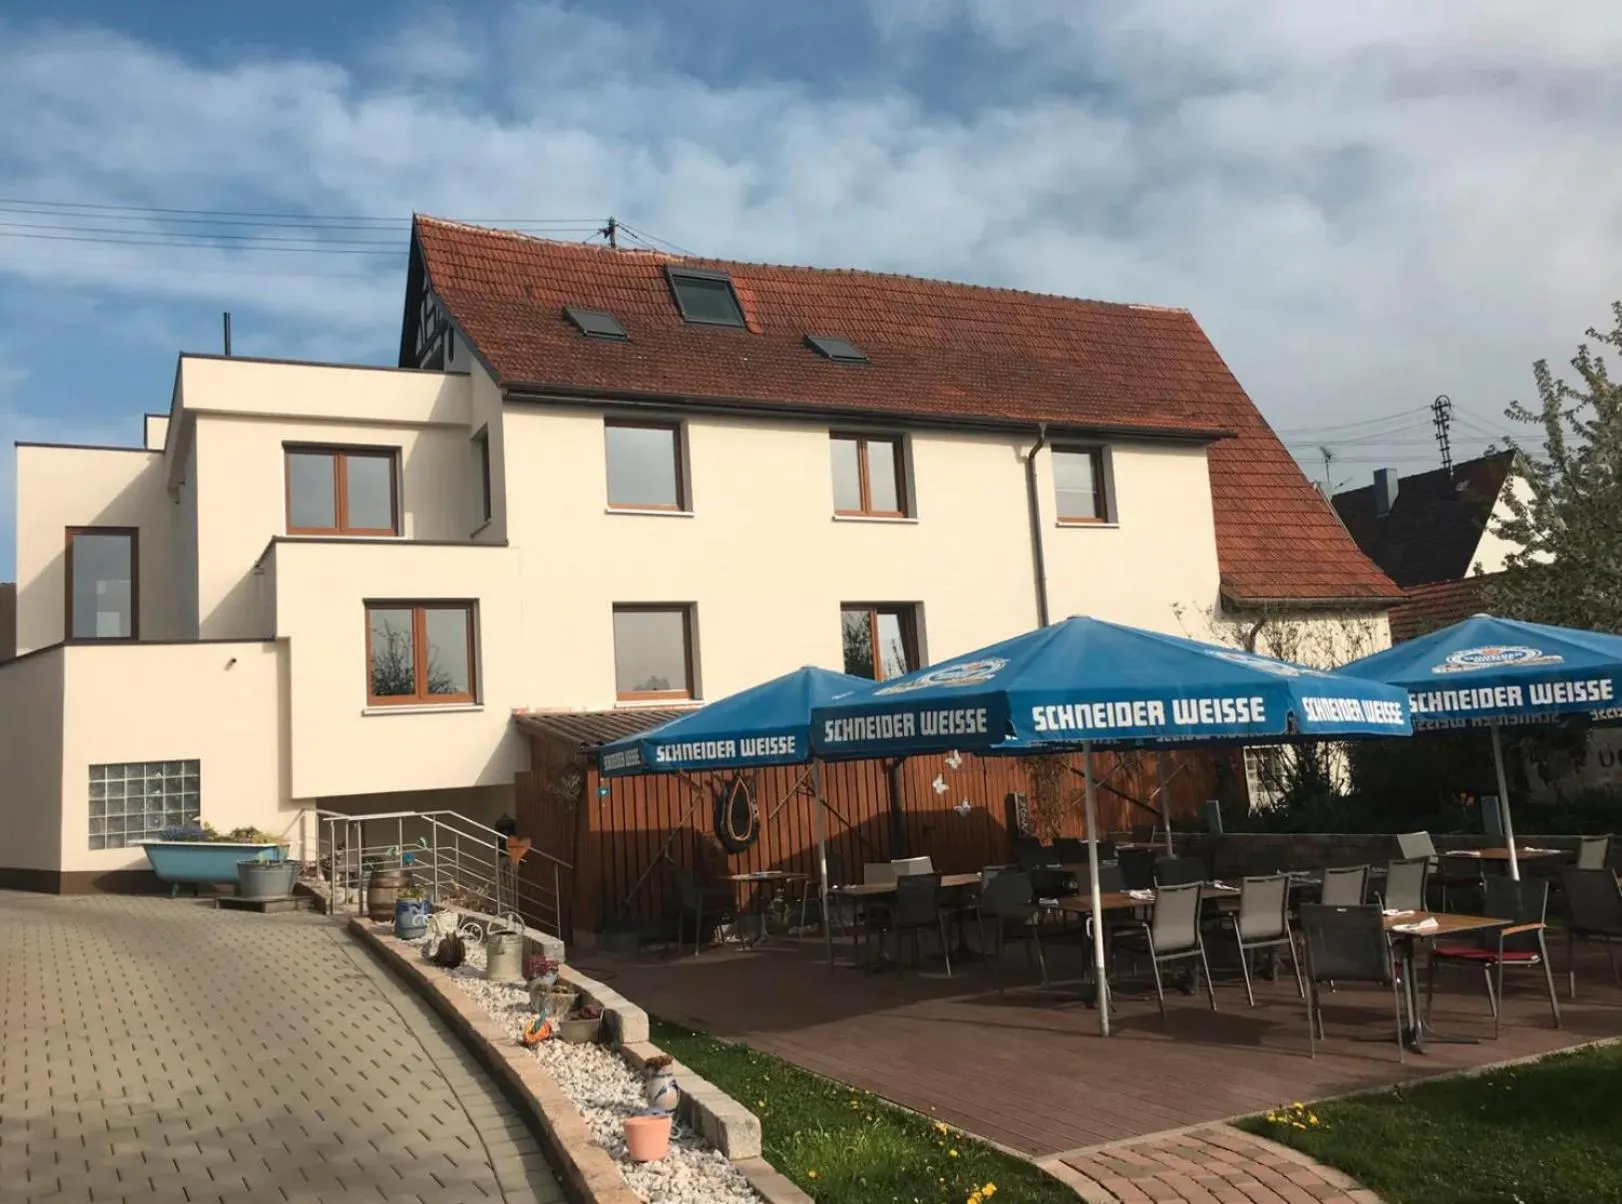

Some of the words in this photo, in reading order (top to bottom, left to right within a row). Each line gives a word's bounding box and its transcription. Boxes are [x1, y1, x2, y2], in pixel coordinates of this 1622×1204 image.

[1302, 697, 1366, 722] SCHNEIDER
[1361, 700, 1405, 725] WEISSE
[1409, 686, 1523, 712] SCHNEIDER
[1529, 679, 1614, 704] WEISSE
[824, 712, 915, 742] SCHNEIDER
[920, 708, 987, 736] WEISSE
[1032, 700, 1165, 731] SCHNEIDER
[1172, 697, 1265, 725] WEISSE
[656, 740, 736, 762] SCHNEIDER
[740, 736, 796, 757] WEISSE
